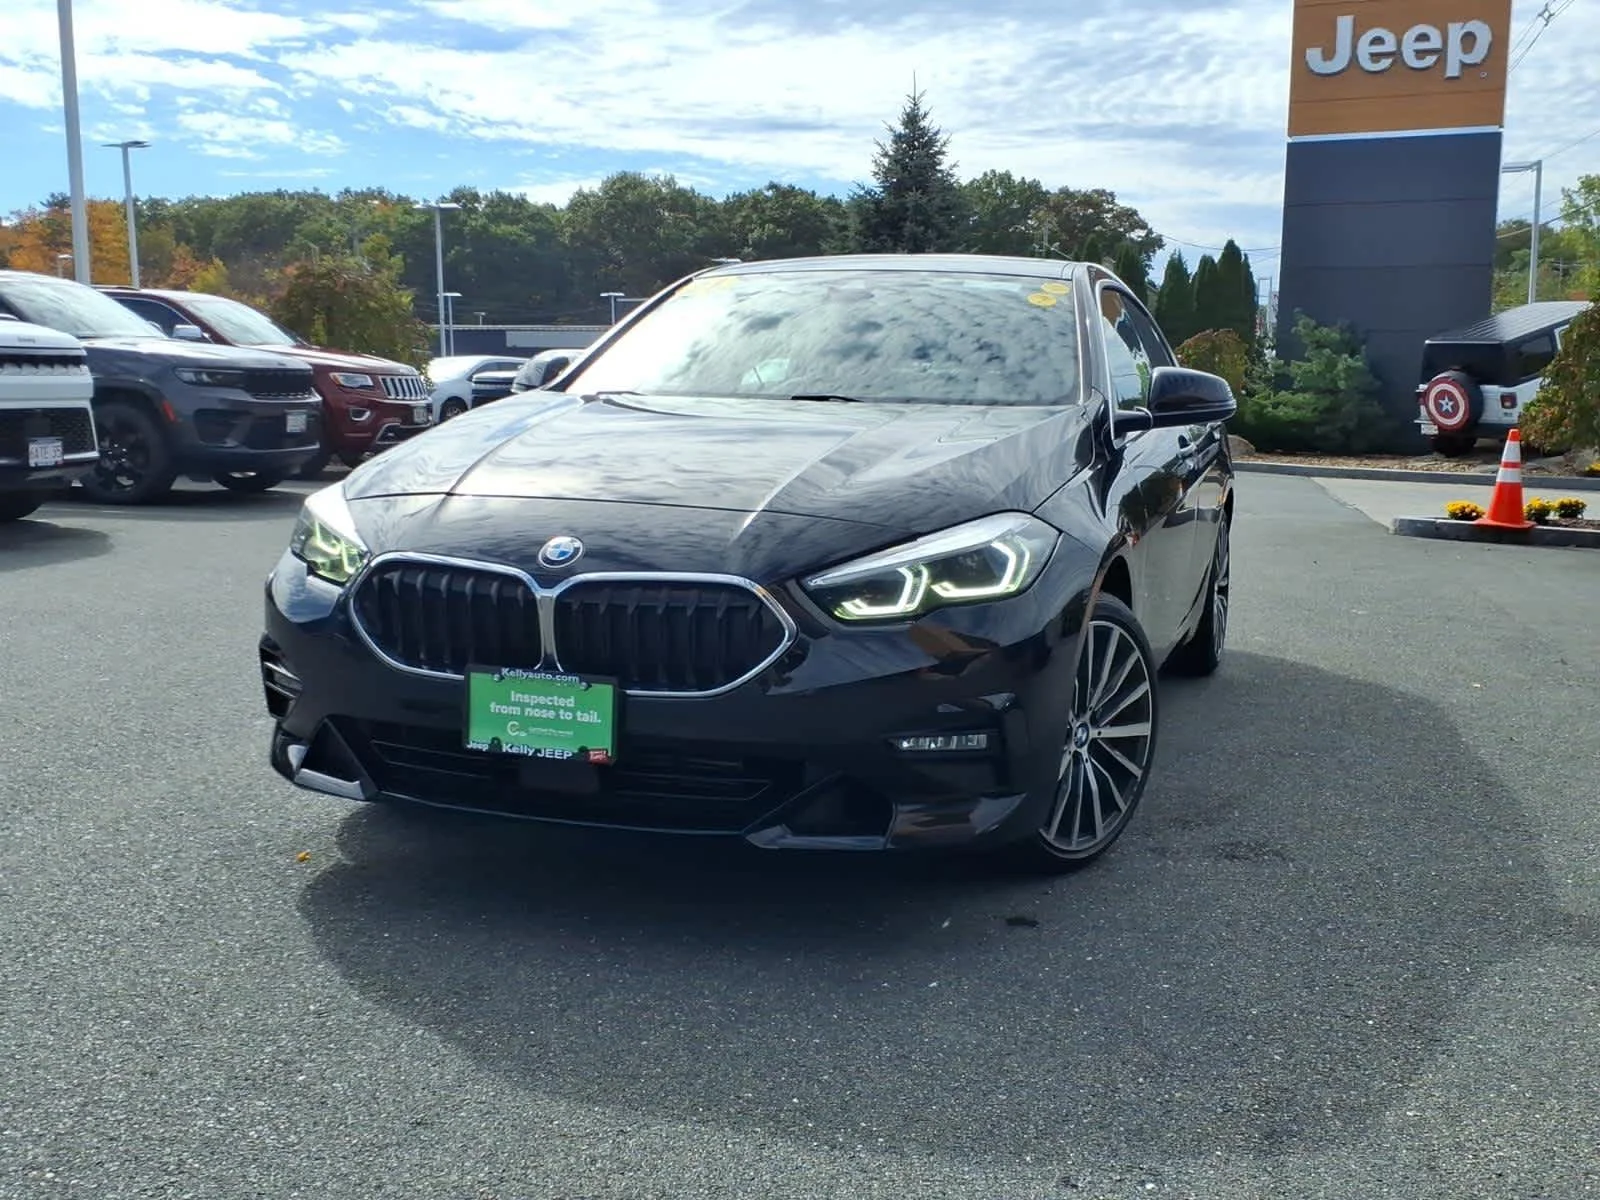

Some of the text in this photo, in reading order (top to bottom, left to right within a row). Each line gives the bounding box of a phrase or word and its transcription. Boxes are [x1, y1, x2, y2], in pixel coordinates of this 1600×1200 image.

[1305, 14, 1493, 79] Jeep
[501, 667, 580, 684] Kellyauto.com
[511, 691, 575, 707] Inspected
[490, 702, 602, 724] from nose to tail.
[466, 740, 489, 751] Jeep
[502, 743, 573, 760] Kelly JEEP
